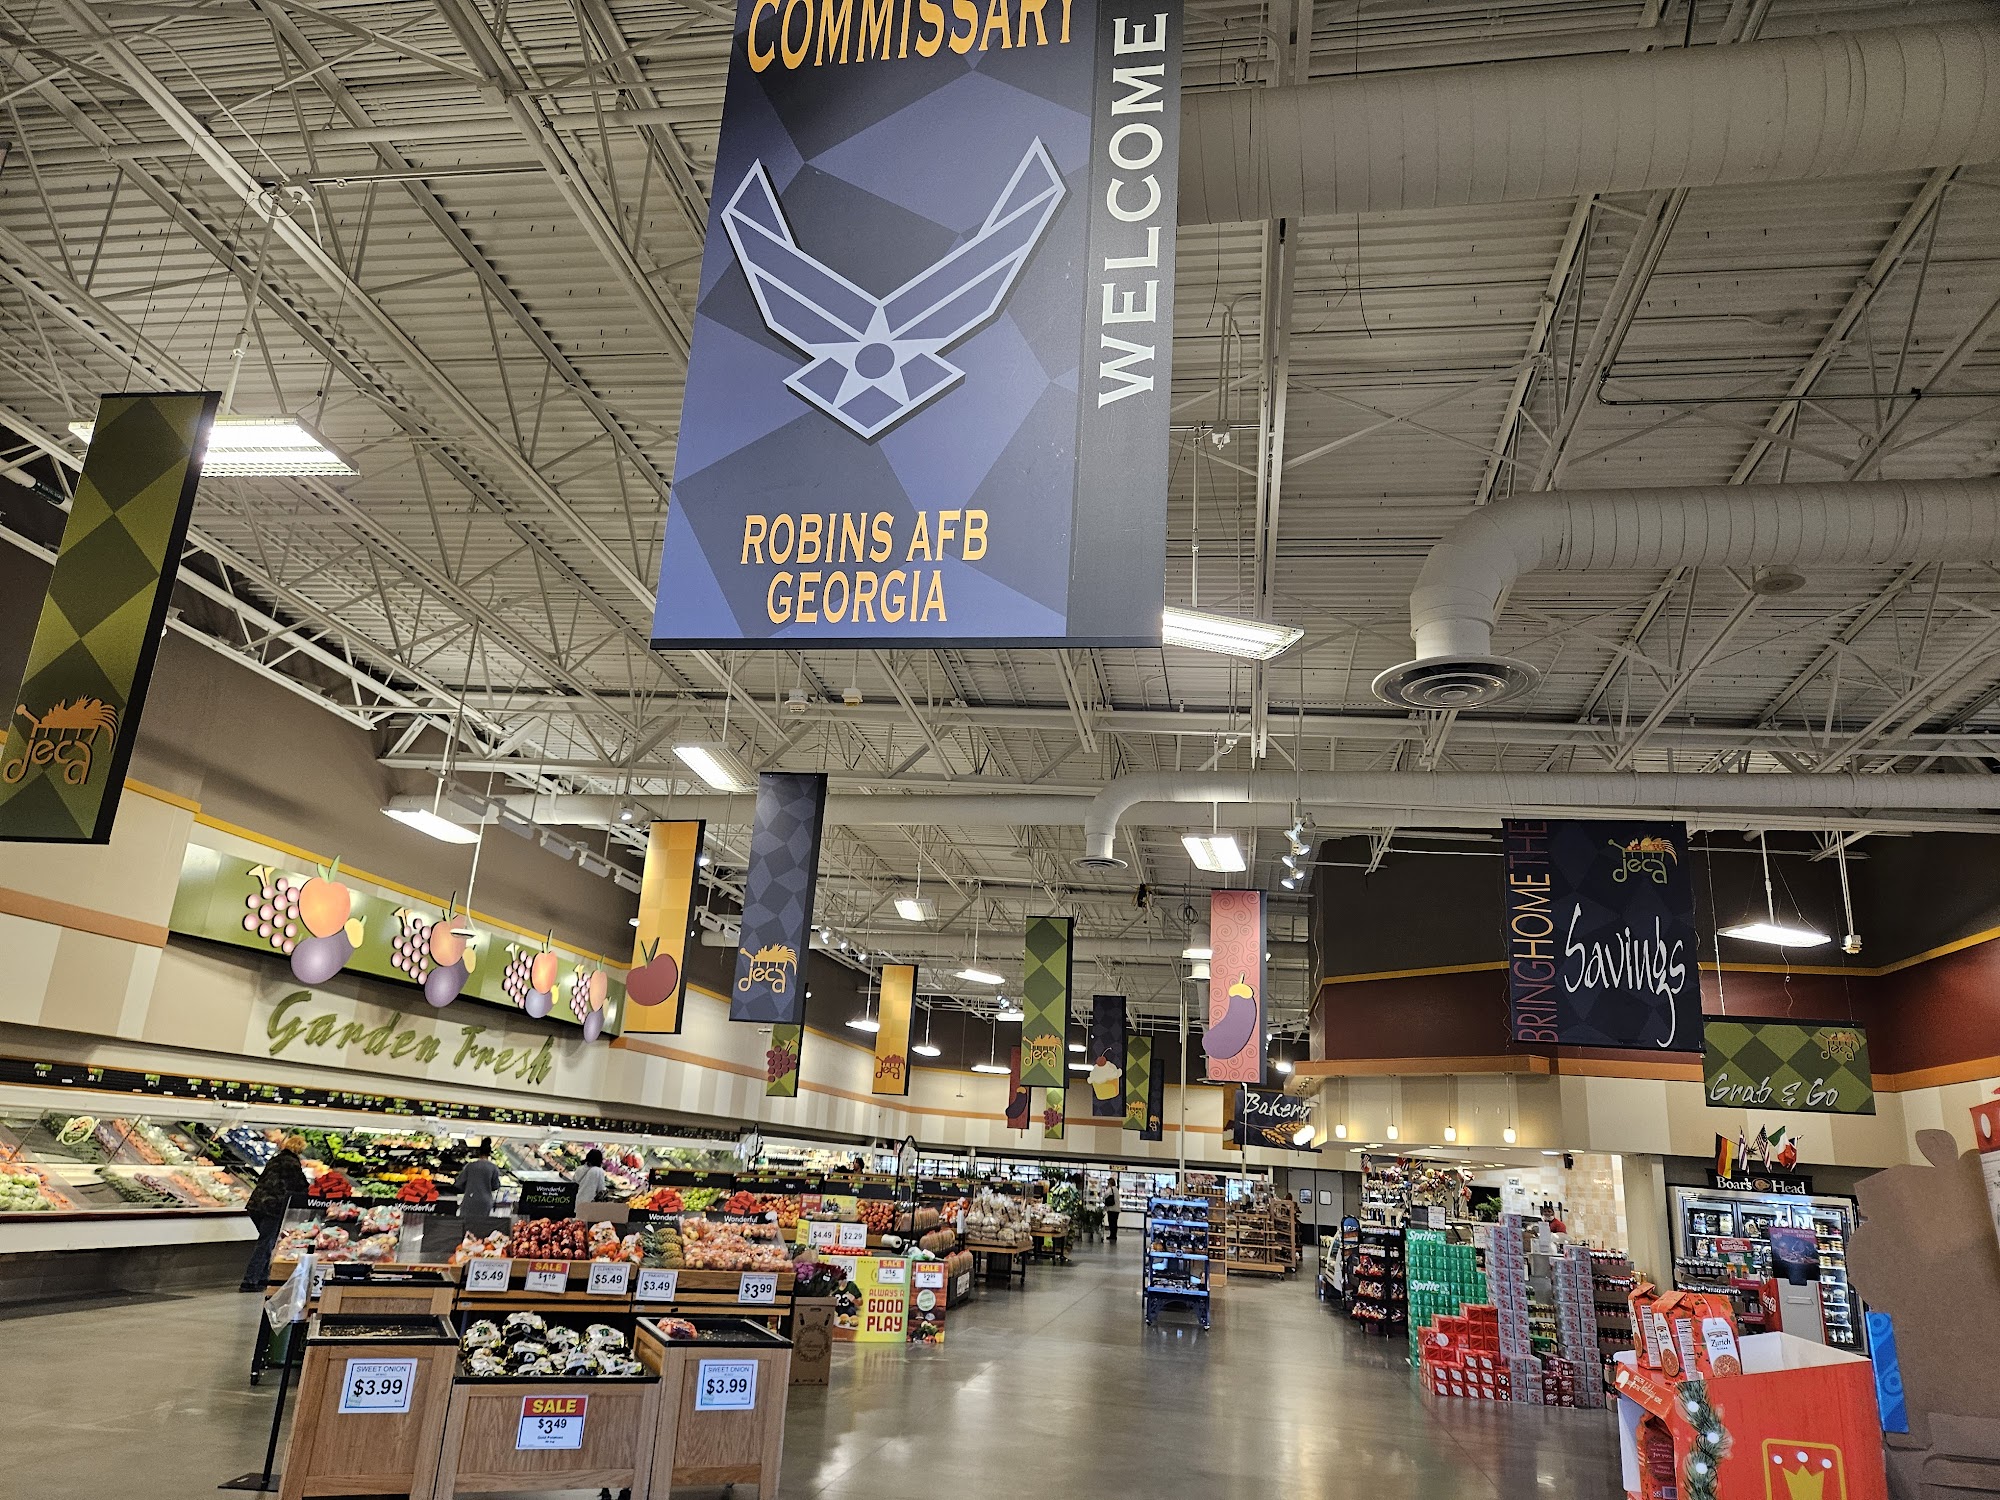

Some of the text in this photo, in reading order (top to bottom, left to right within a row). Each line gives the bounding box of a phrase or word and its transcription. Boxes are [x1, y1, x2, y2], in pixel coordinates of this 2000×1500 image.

[747, 0, 1074, 72] COMMISSARY
[1098, 12, 1169, 408] WELCOME
[740, 508, 990, 565] ROBINS AFB
[767, 570, 948, 625] GEORGIA
[1563, 902, 1686, 1048] Savings
[267, 990, 555, 1085] Garden Fresh
[1710, 1073, 1840, 1107] Grab & Go
[1243, 1093, 1311, 1125] Bakery
[1716, 1176, 1806, 1194] Boar's Head
[526, 1195, 571, 1204] PISTACHIOS
[724, 1215, 758, 1223] Wonderful
[813, 1231, 832, 1239] $4.49
[844, 1232, 863, 1240] $2.29
[1407, 1231, 1437, 1241] Sprite
[534, 1262, 562, 1272] SALE
[882, 1260, 902, 1268] SALE
[474, 1270, 504, 1281] $5.49
[594, 1274, 623, 1285] $5.49
[643, 1280, 670, 1291] $3.49
[1410, 1280, 1440, 1292] Sprite
[869, 1289, 898, 1297] ALWAYS
[868, 1299, 903, 1313] GOOD
[866, 1316, 903, 1332] PLAY
[1711, 1338, 1731, 1347] Zurich
[353, 1378, 403, 1397] $3.99
[706, 1378, 747, 1395] $3.99
[532, 1399, 577, 1414] SALE
